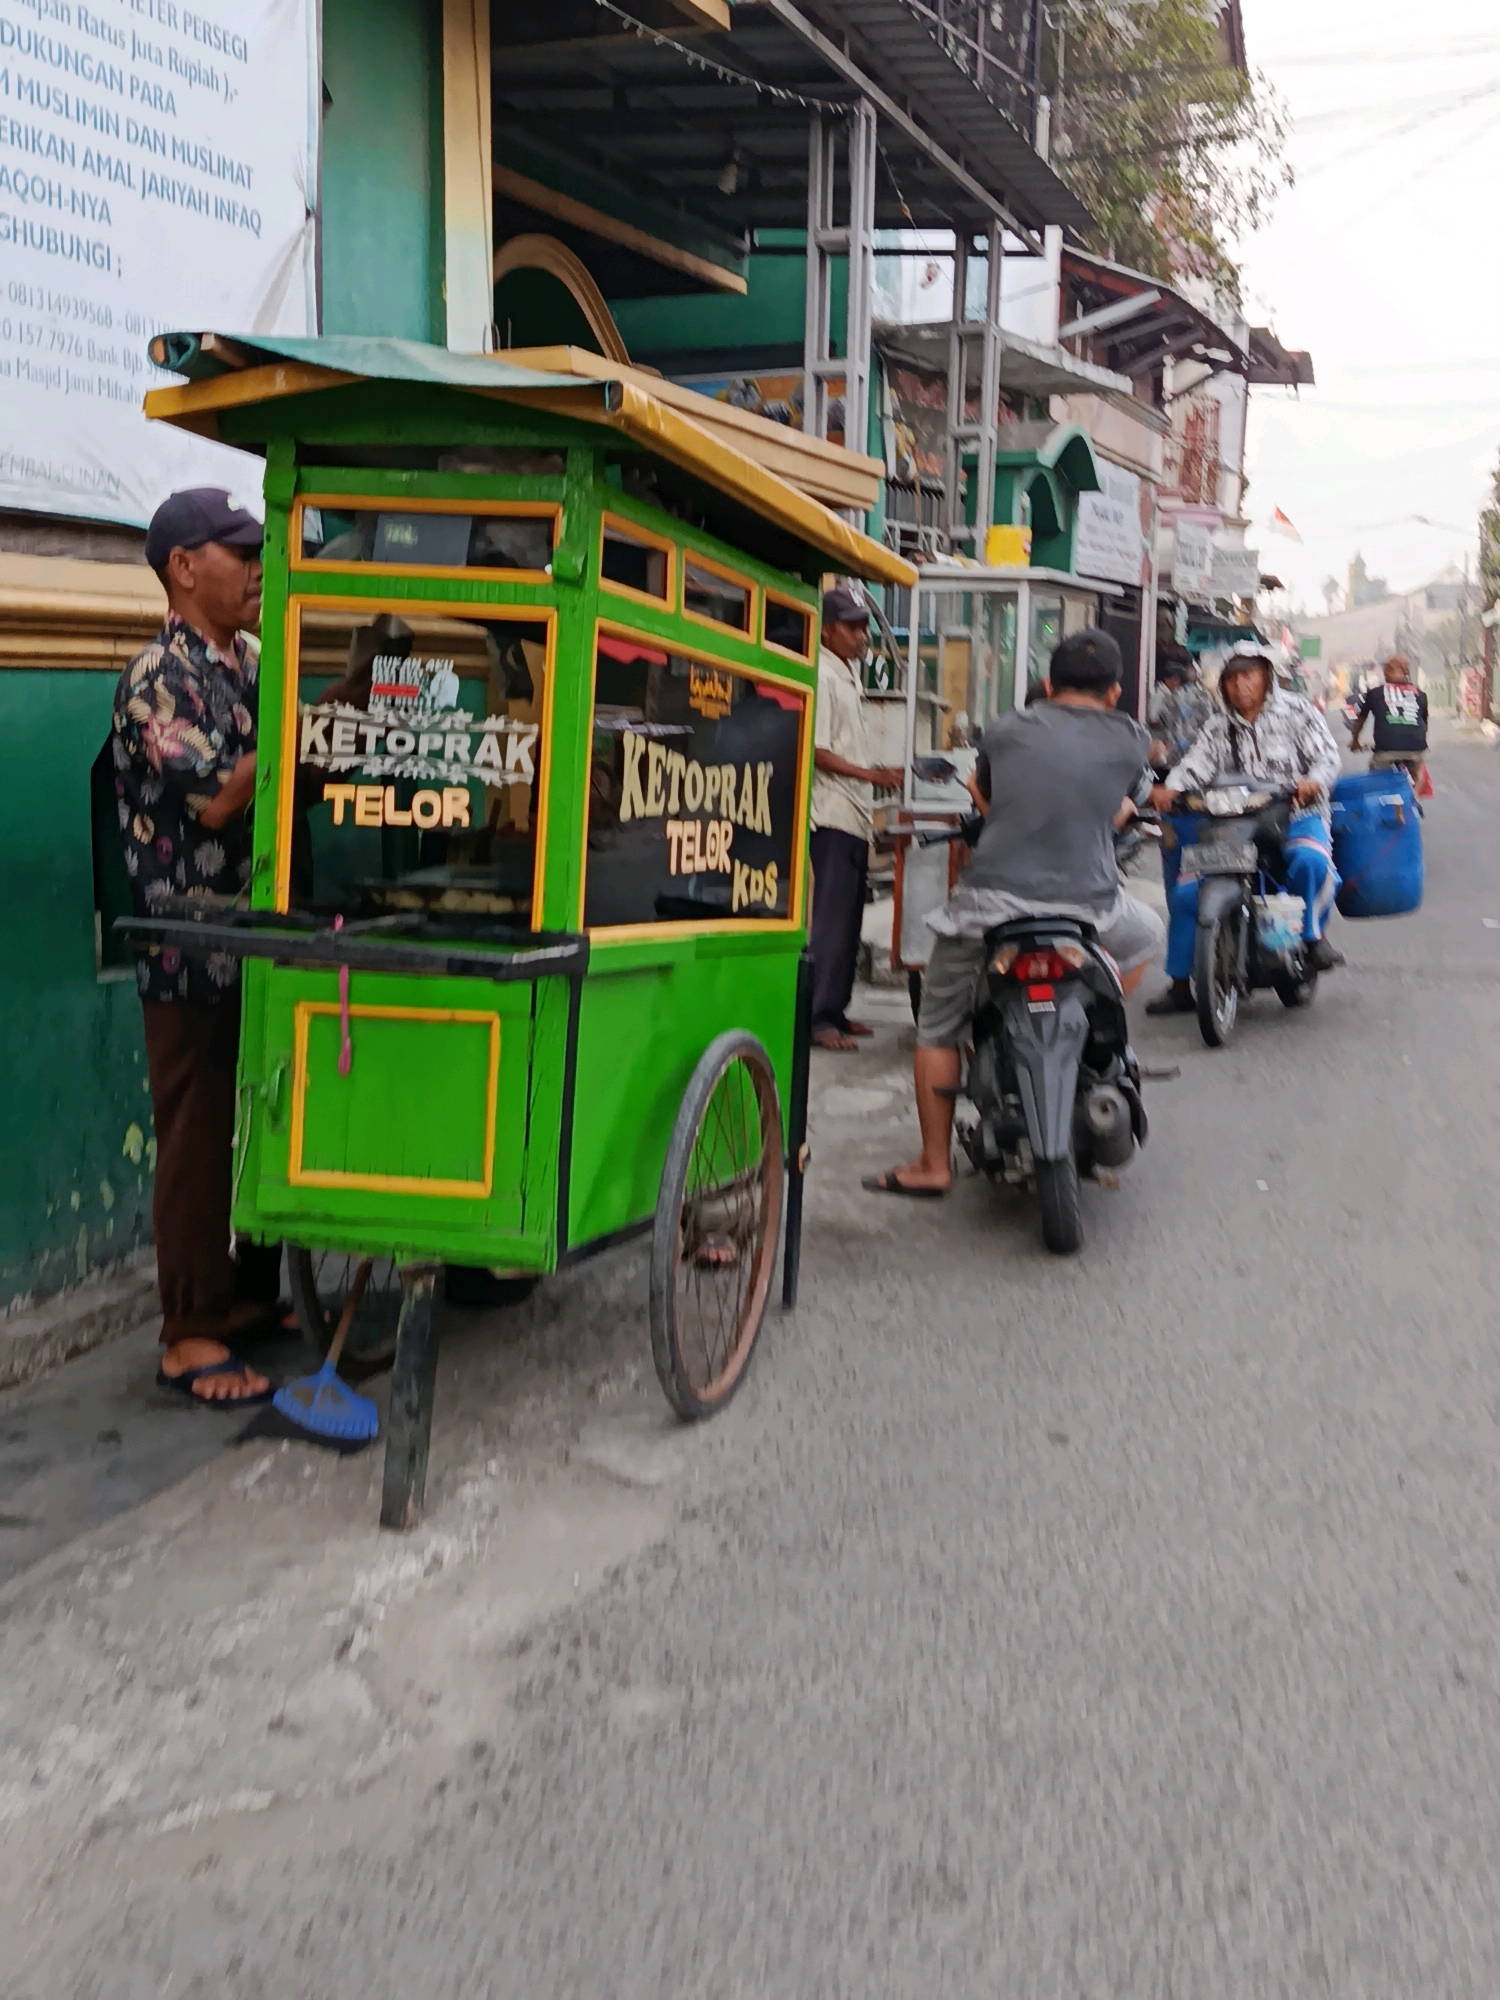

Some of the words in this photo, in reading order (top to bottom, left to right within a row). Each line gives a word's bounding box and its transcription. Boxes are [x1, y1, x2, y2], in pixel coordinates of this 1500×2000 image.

[0, 16, 123, 96] DUKUNGAN
[129, 73, 177, 118] PARA
[77, 4, 125, 51] Ratus
[168, 45, 219, 93] Rupiah
[183, 8, 247, 65] PERSEGI
[17, 71, 119, 140] MUSLIMIN
[126, 115, 165, 158] DAN
[172, 133, 253, 191] MUSLIMAT
[81, 145, 137, 192] AMAL
[141, 166, 209, 217] JARIYAH
[214, 193, 262, 240] INFAQ
[300, 704, 538, 785] KETOPRAK
[619, 729, 773, 836] KETOPRAK
[323, 783, 470, 829] TELOR
[666, 820, 733, 876] TELOR
